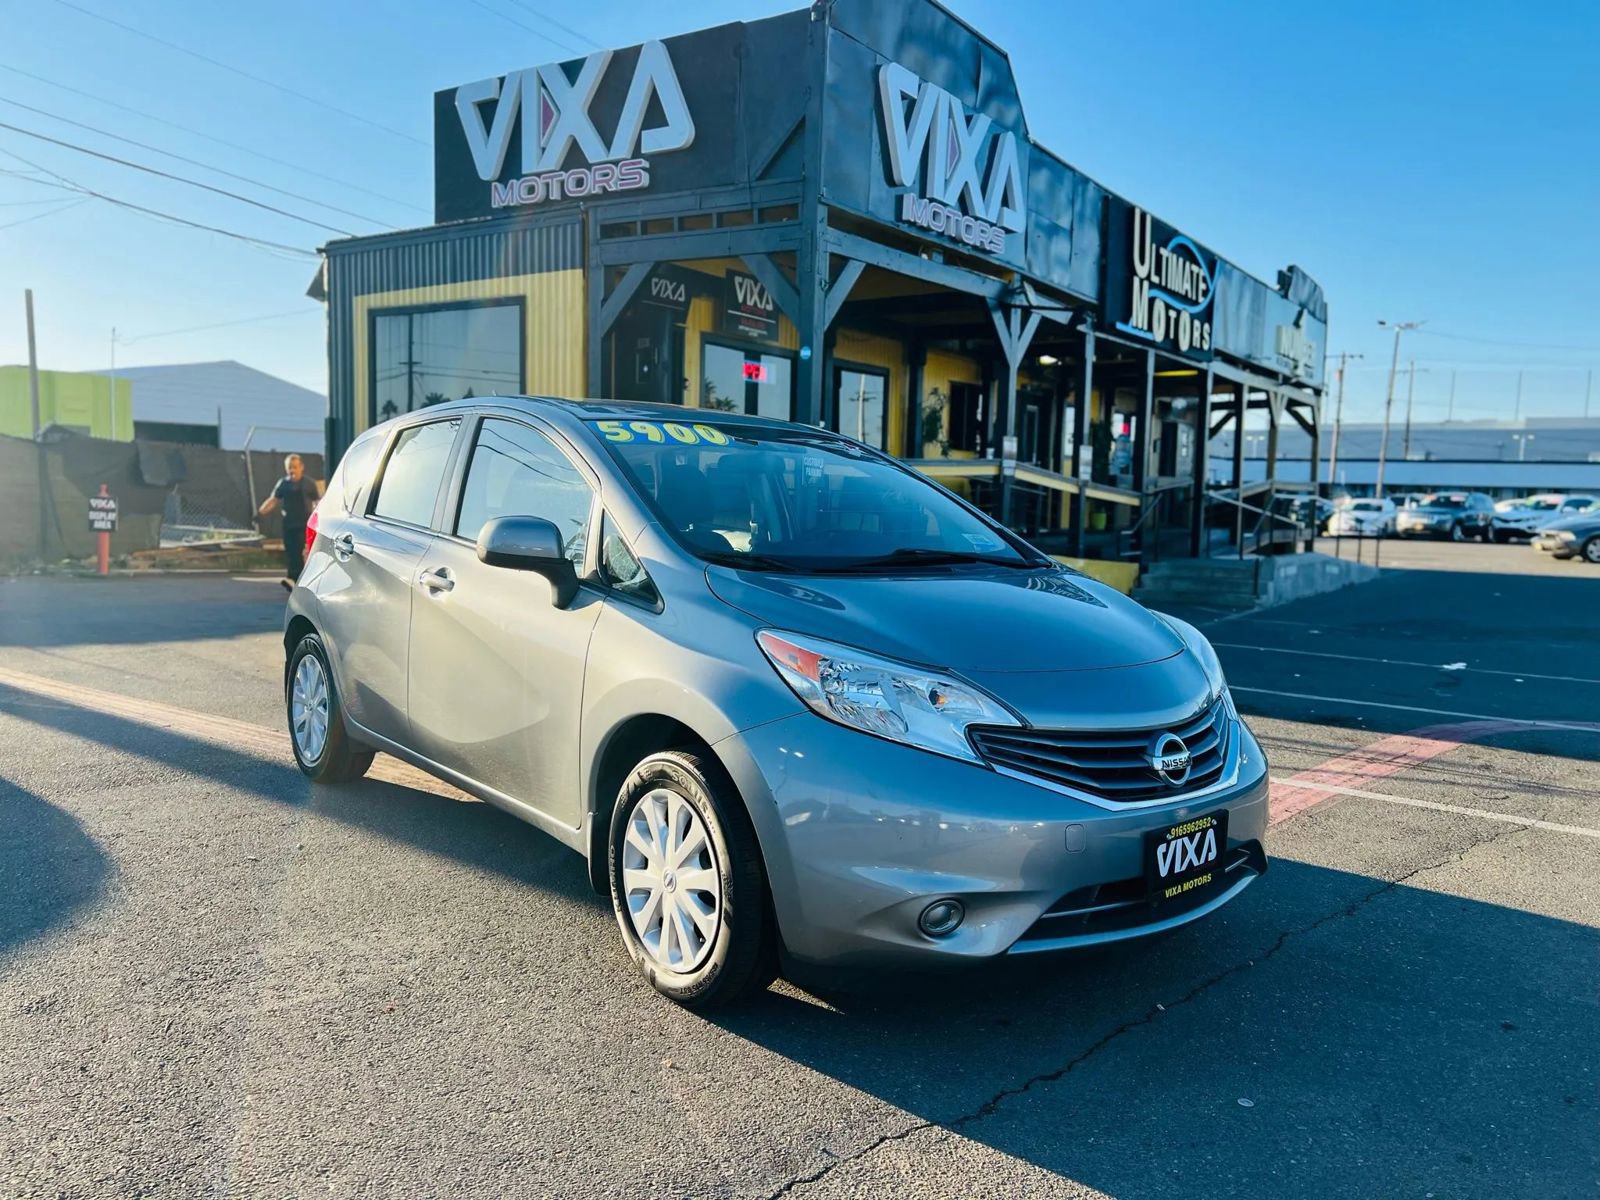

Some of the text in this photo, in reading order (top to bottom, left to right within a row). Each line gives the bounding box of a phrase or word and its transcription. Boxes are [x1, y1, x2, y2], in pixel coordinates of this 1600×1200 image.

[455, 40, 695, 181] VIXA
[879, 62, 1026, 233] VIXA
[491, 158, 649, 208] MOTORS
[902, 193, 1005, 253] MOTORS
[651, 277, 686, 302] VIXA
[734, 275, 774, 311] VIXA
[596, 421, 730, 446] 5900
[1157, 828, 1217, 877] VIXA
[1165, 873, 1212, 898] VIXA MOTORS
